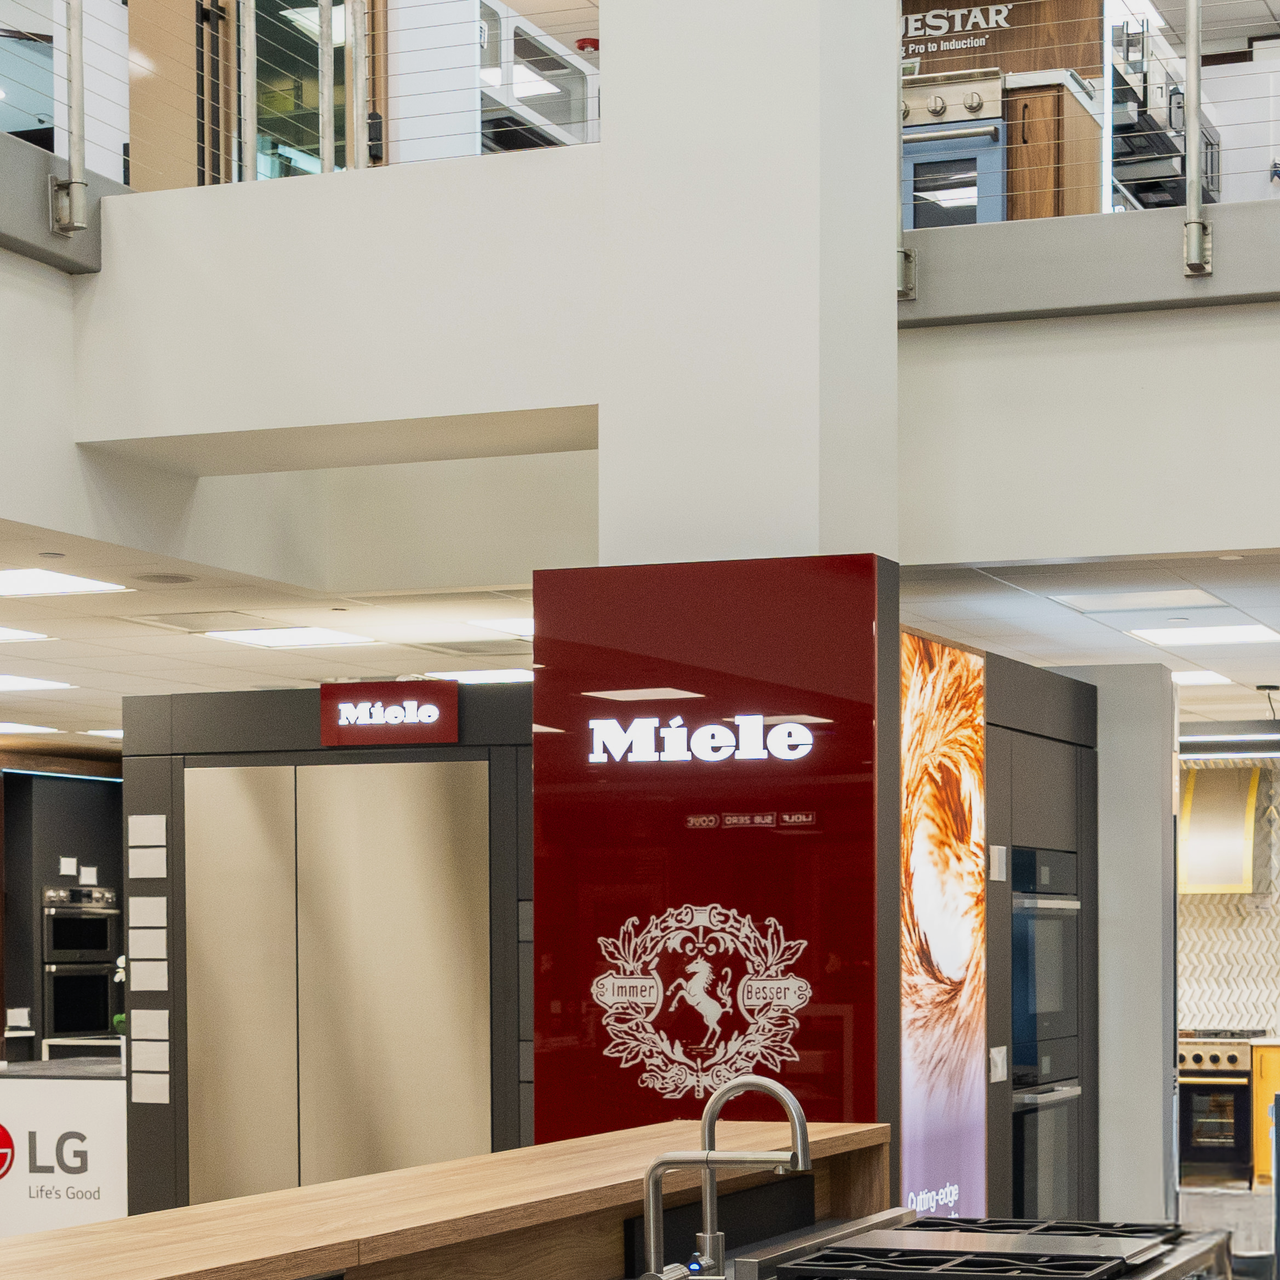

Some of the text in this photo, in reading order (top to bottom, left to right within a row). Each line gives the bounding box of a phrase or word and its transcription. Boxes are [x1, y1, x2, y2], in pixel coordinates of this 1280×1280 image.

[908, 43, 925, 54] Pro
[927, 42, 938, 52] to
[338, 700, 440, 726] Miele
[588, 714, 814, 763] Miele
[611, 981, 655, 998] Immer
[746, 984, 790, 1001] Besser
[28, 1131, 88, 1174] LG
[65, 1185, 101, 1200] Good
